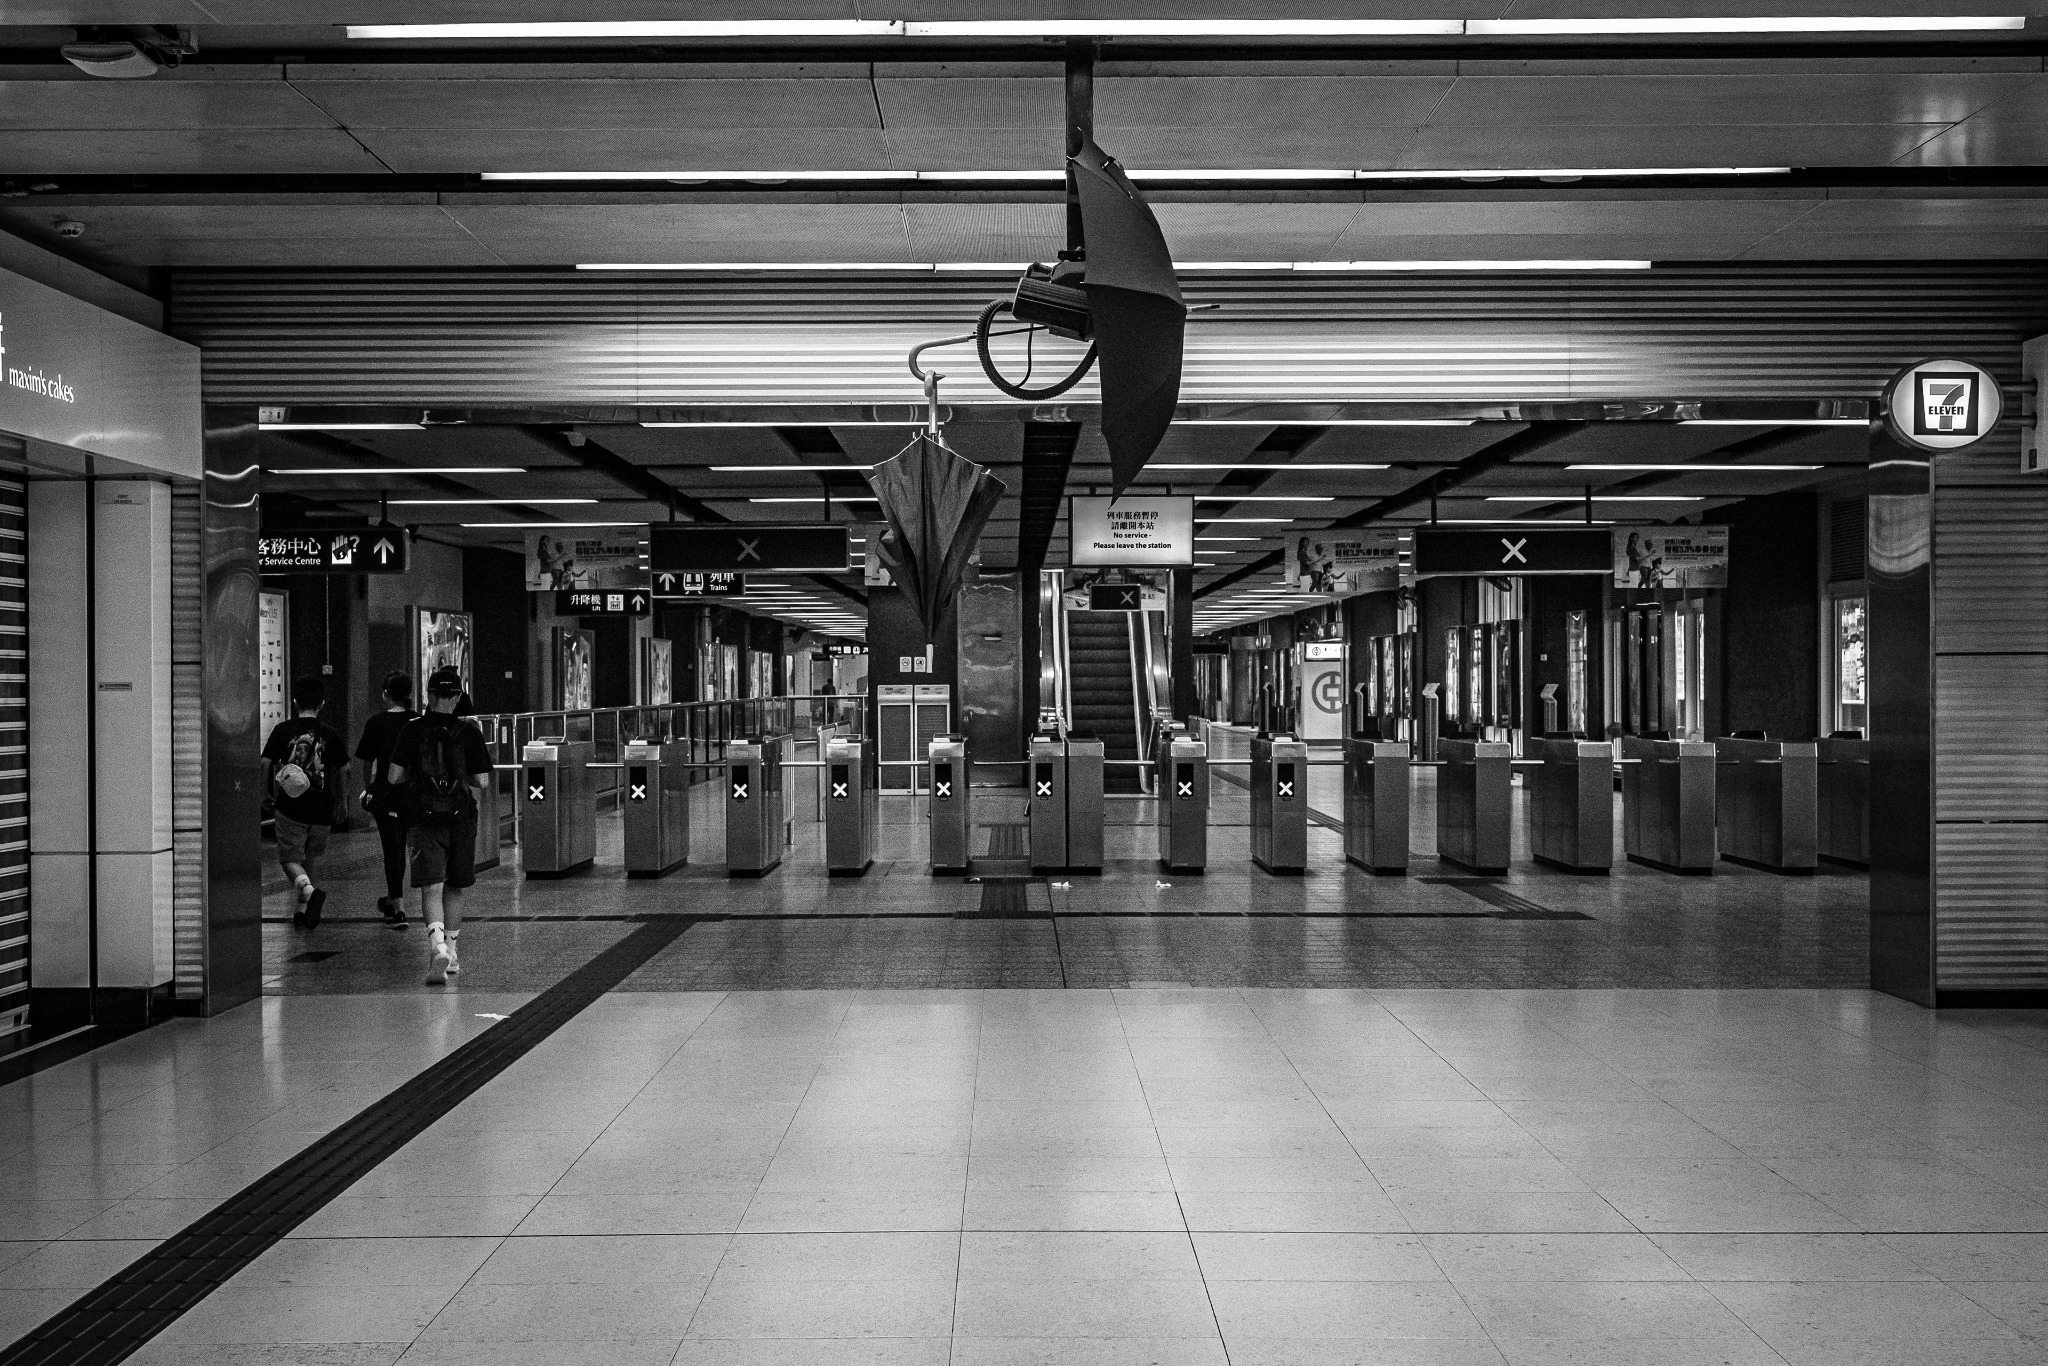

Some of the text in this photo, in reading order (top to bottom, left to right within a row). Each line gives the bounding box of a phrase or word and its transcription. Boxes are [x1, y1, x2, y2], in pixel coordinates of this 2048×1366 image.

[9, 366, 75, 403] maxim's cakes
[1930, 384, 1964, 429] 7
[1107, 511, 1158, 520] 列車服務暫停
[1111, 521, 1155, 530] 請離開本站
[265, 557, 294, 566] Service
[295, 557, 321, 566] Centre
[709, 584, 728, 592] Trains
[571, 594, 601, 605] 升降機
